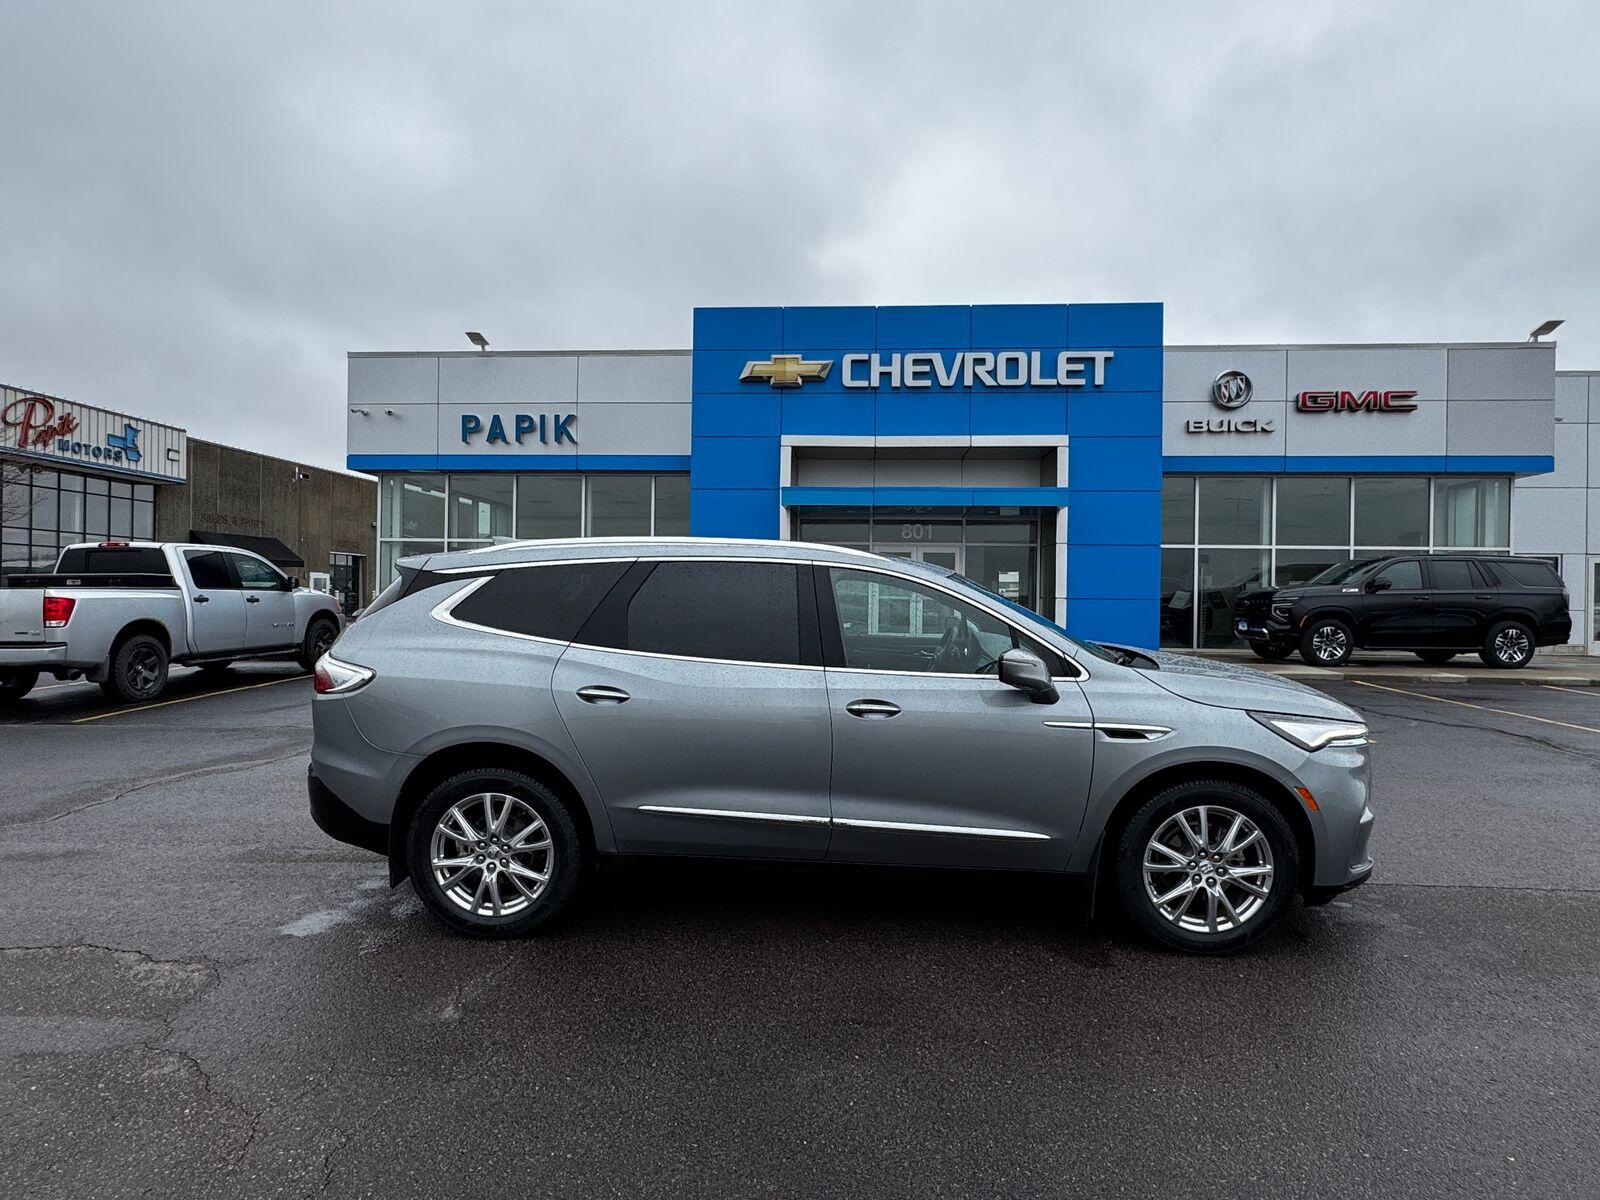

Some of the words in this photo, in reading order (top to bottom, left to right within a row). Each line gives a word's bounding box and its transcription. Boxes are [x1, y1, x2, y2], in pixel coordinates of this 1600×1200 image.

[842, 351, 1115, 387] CHEVROLET
[1298, 390, 1418, 412] GMC
[2, 396, 80, 448] Papik
[461, 414, 578, 444] PAPIK
[1186, 418, 1276, 433] BUICK
[57, 438, 123, 462] MOTORS
[901, 523, 933, 540] 801
